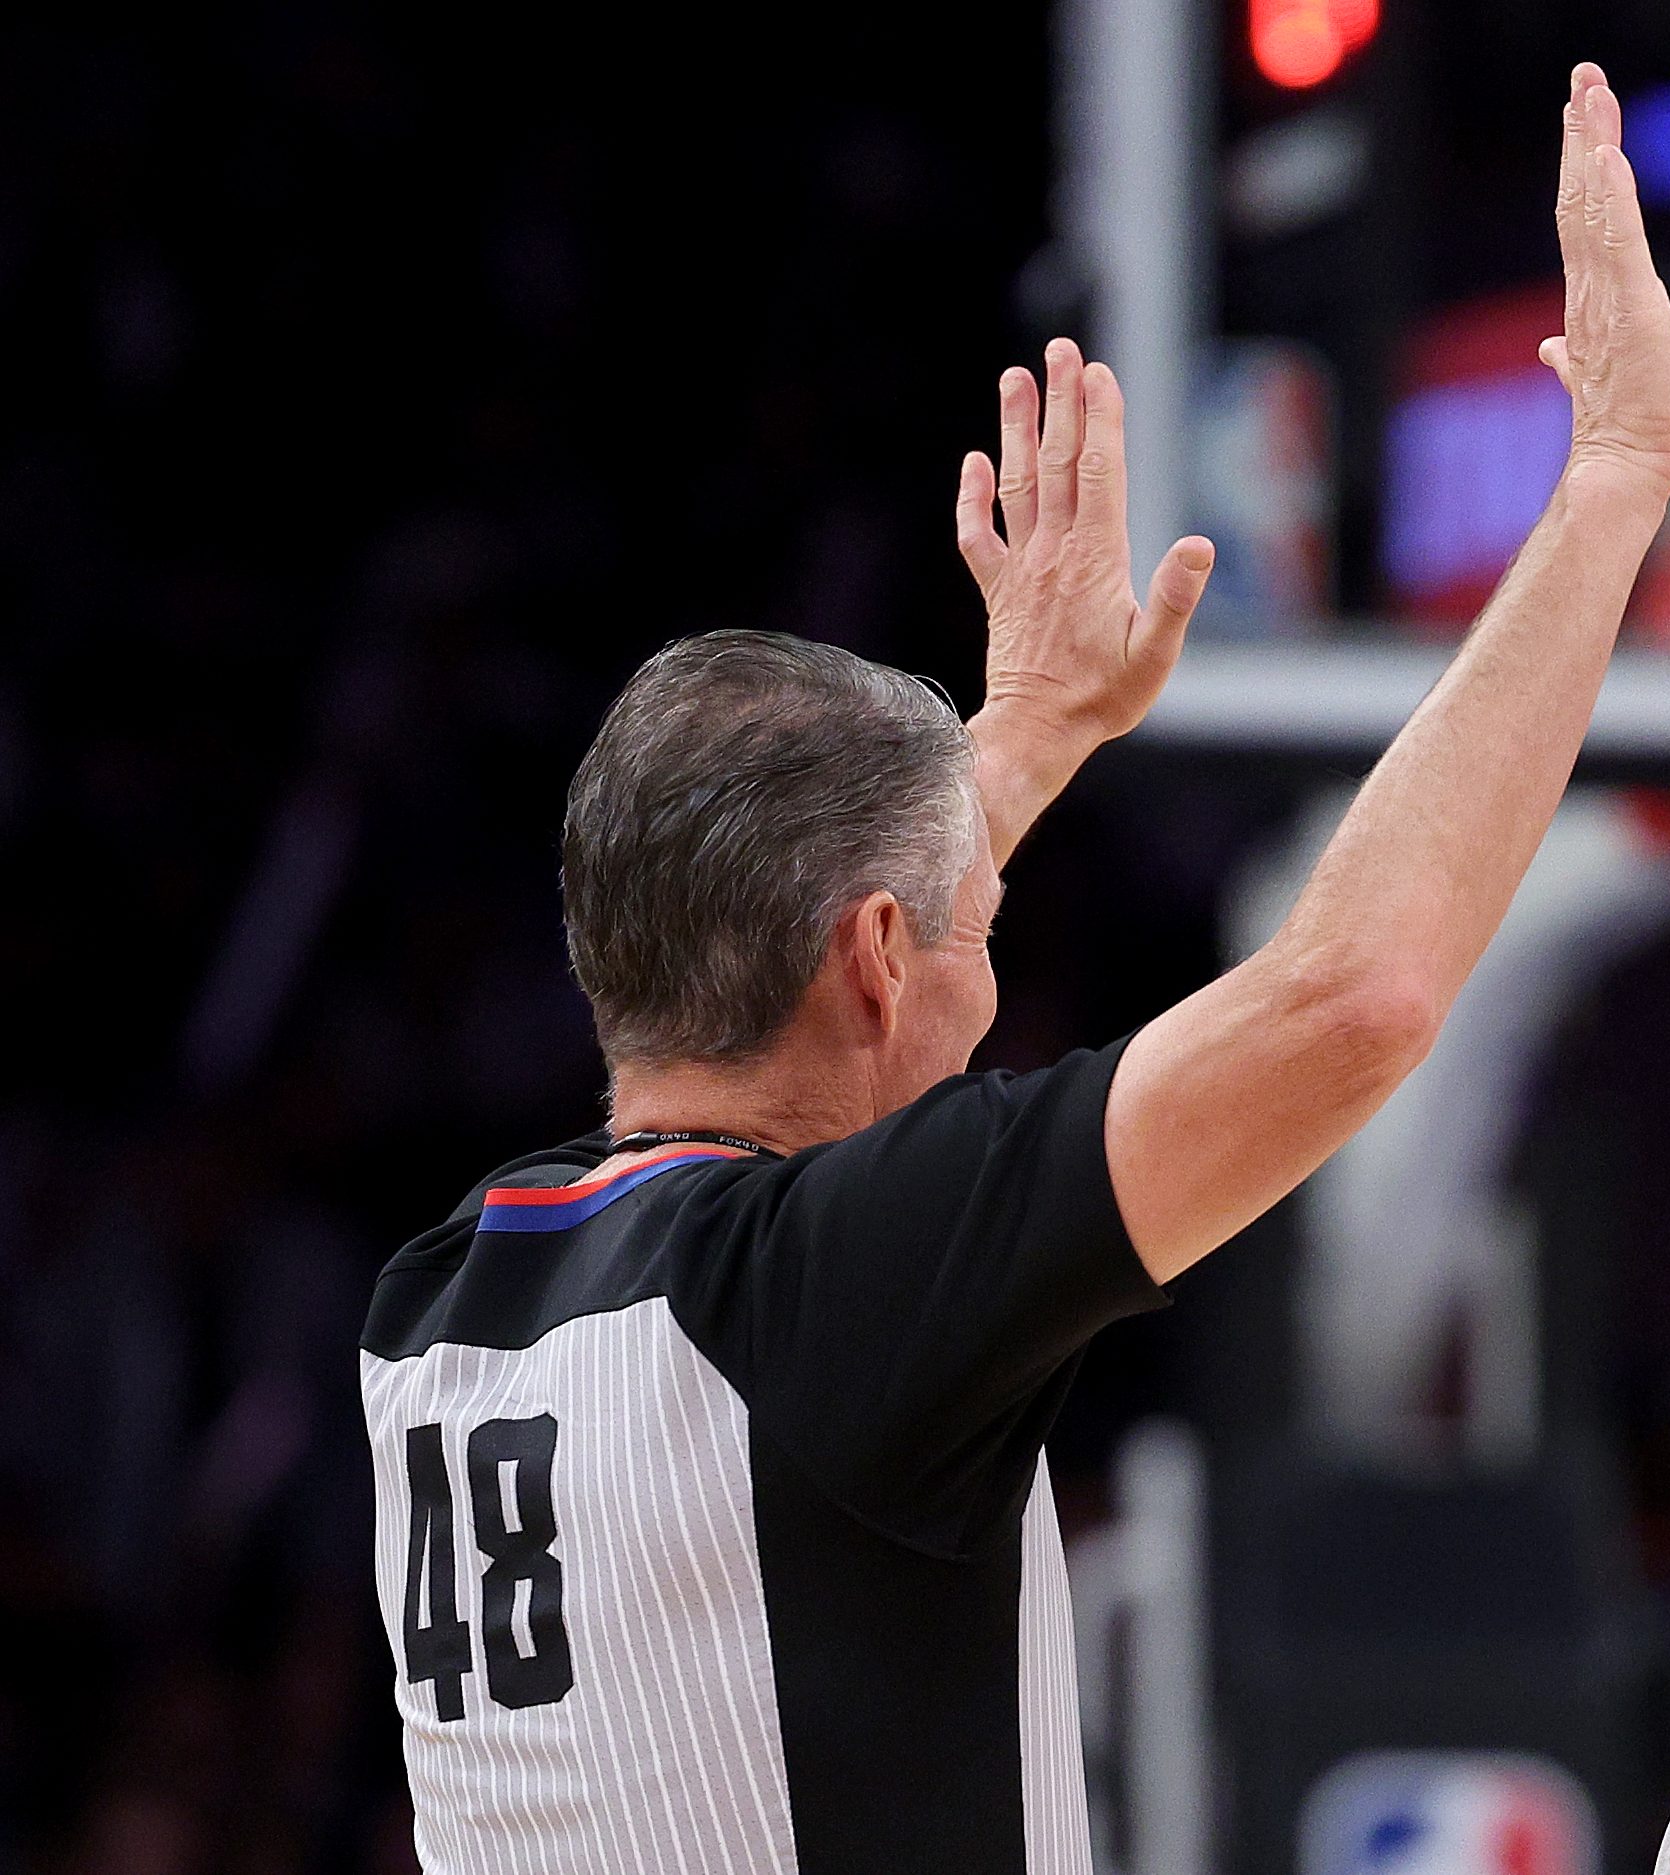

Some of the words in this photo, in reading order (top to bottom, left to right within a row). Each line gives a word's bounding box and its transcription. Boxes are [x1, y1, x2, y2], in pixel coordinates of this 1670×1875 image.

[660, 1132, 690, 1141] OX40
[719, 1135, 759, 1152] FOX40
[402, 1411, 574, 1723] 48
